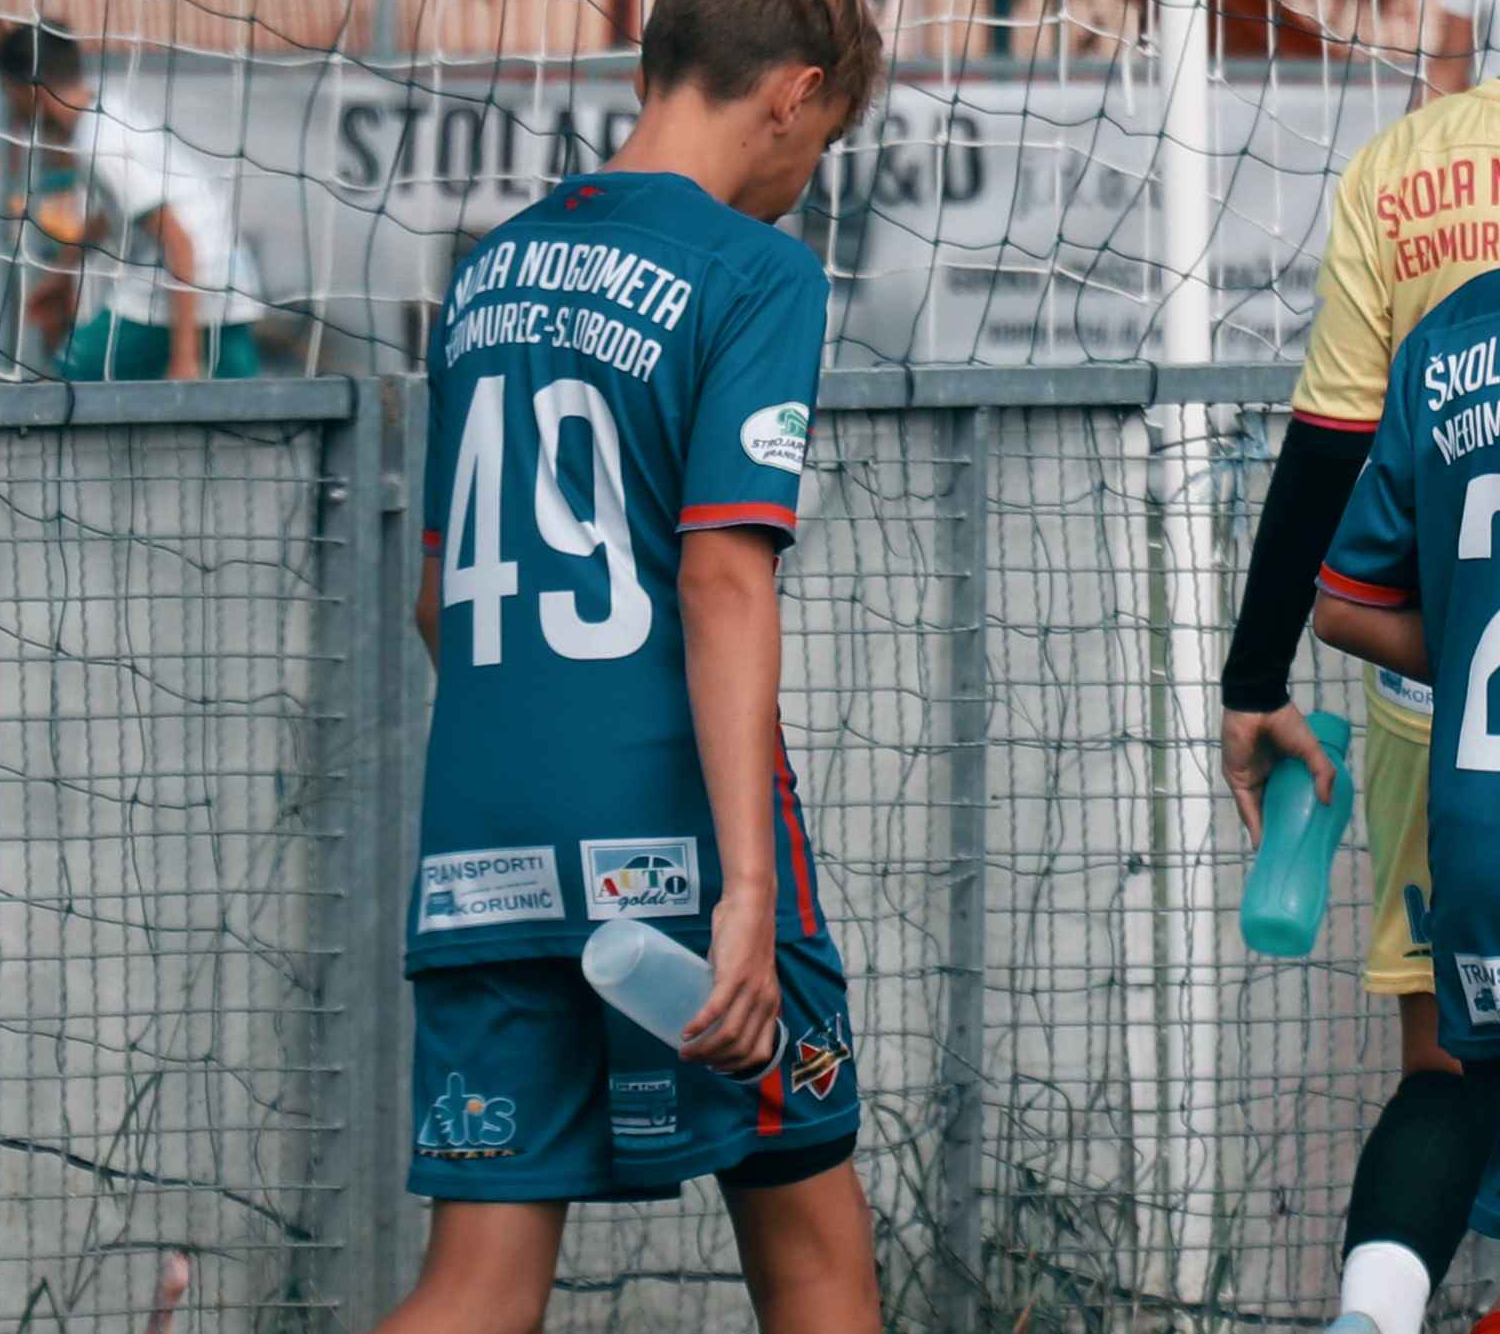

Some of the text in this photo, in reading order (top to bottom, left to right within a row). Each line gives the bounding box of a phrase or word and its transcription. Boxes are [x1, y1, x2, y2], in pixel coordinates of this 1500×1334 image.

[516, 241, 692, 331] NOGOMETA
[442, 375, 653, 666] 49
[422, 856, 543, 884] RANSPORTI
